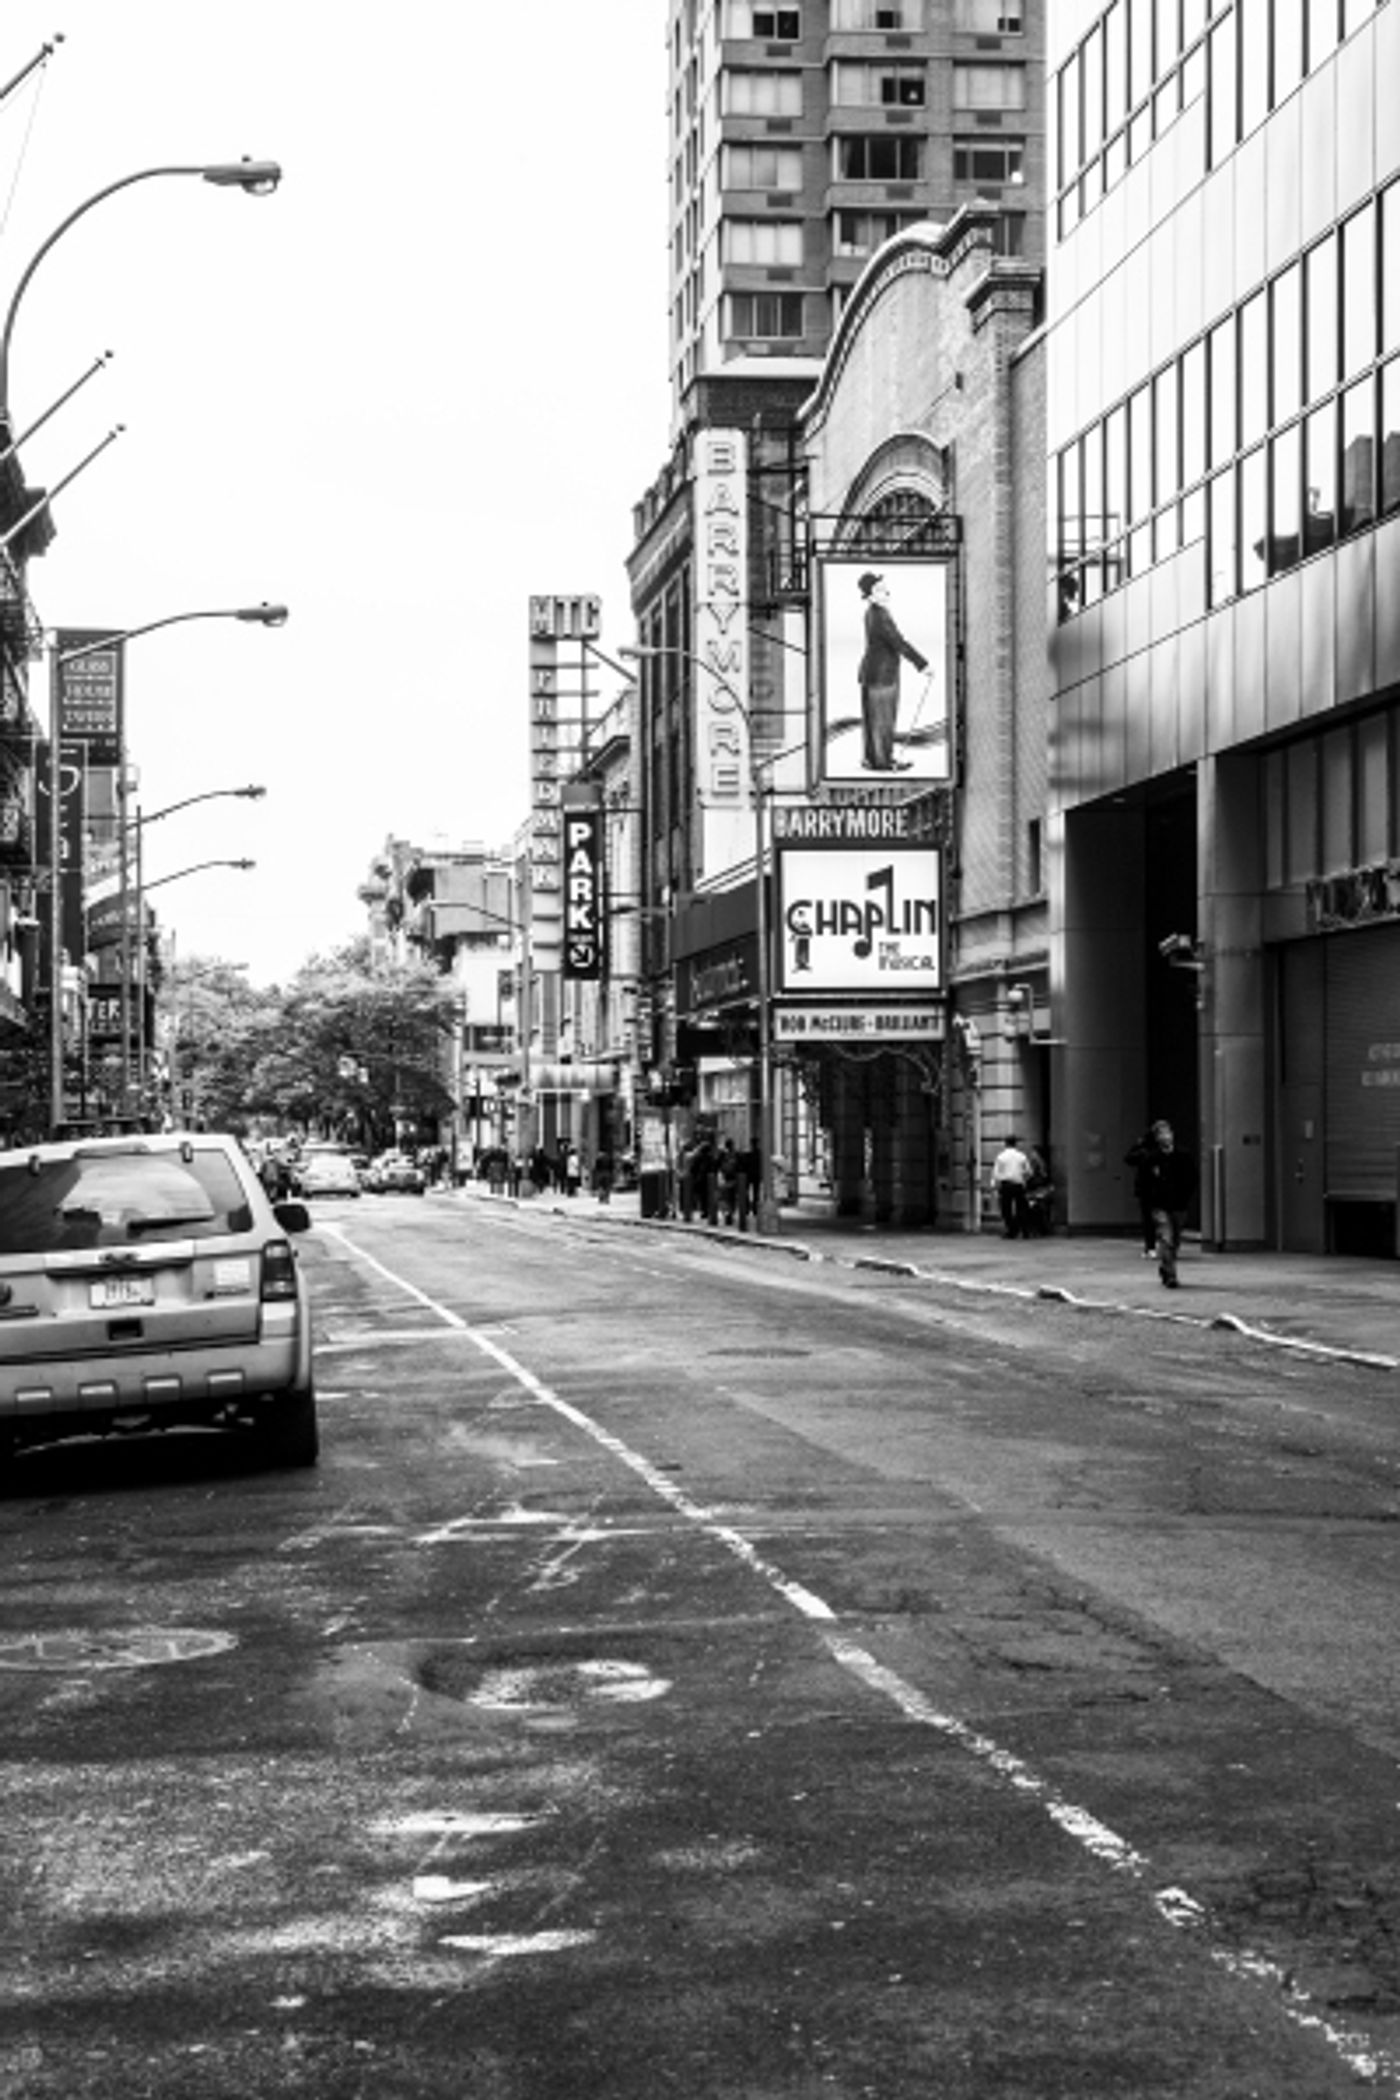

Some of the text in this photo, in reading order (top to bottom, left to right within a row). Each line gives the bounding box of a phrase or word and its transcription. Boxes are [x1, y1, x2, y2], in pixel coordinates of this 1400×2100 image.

[706, 440, 742, 798] BARRYMORE
[774, 807, 909, 838] BARRYMORE
[568, 822, 594, 929] PARK
[787, 865, 937, 959] CHAPLIN
